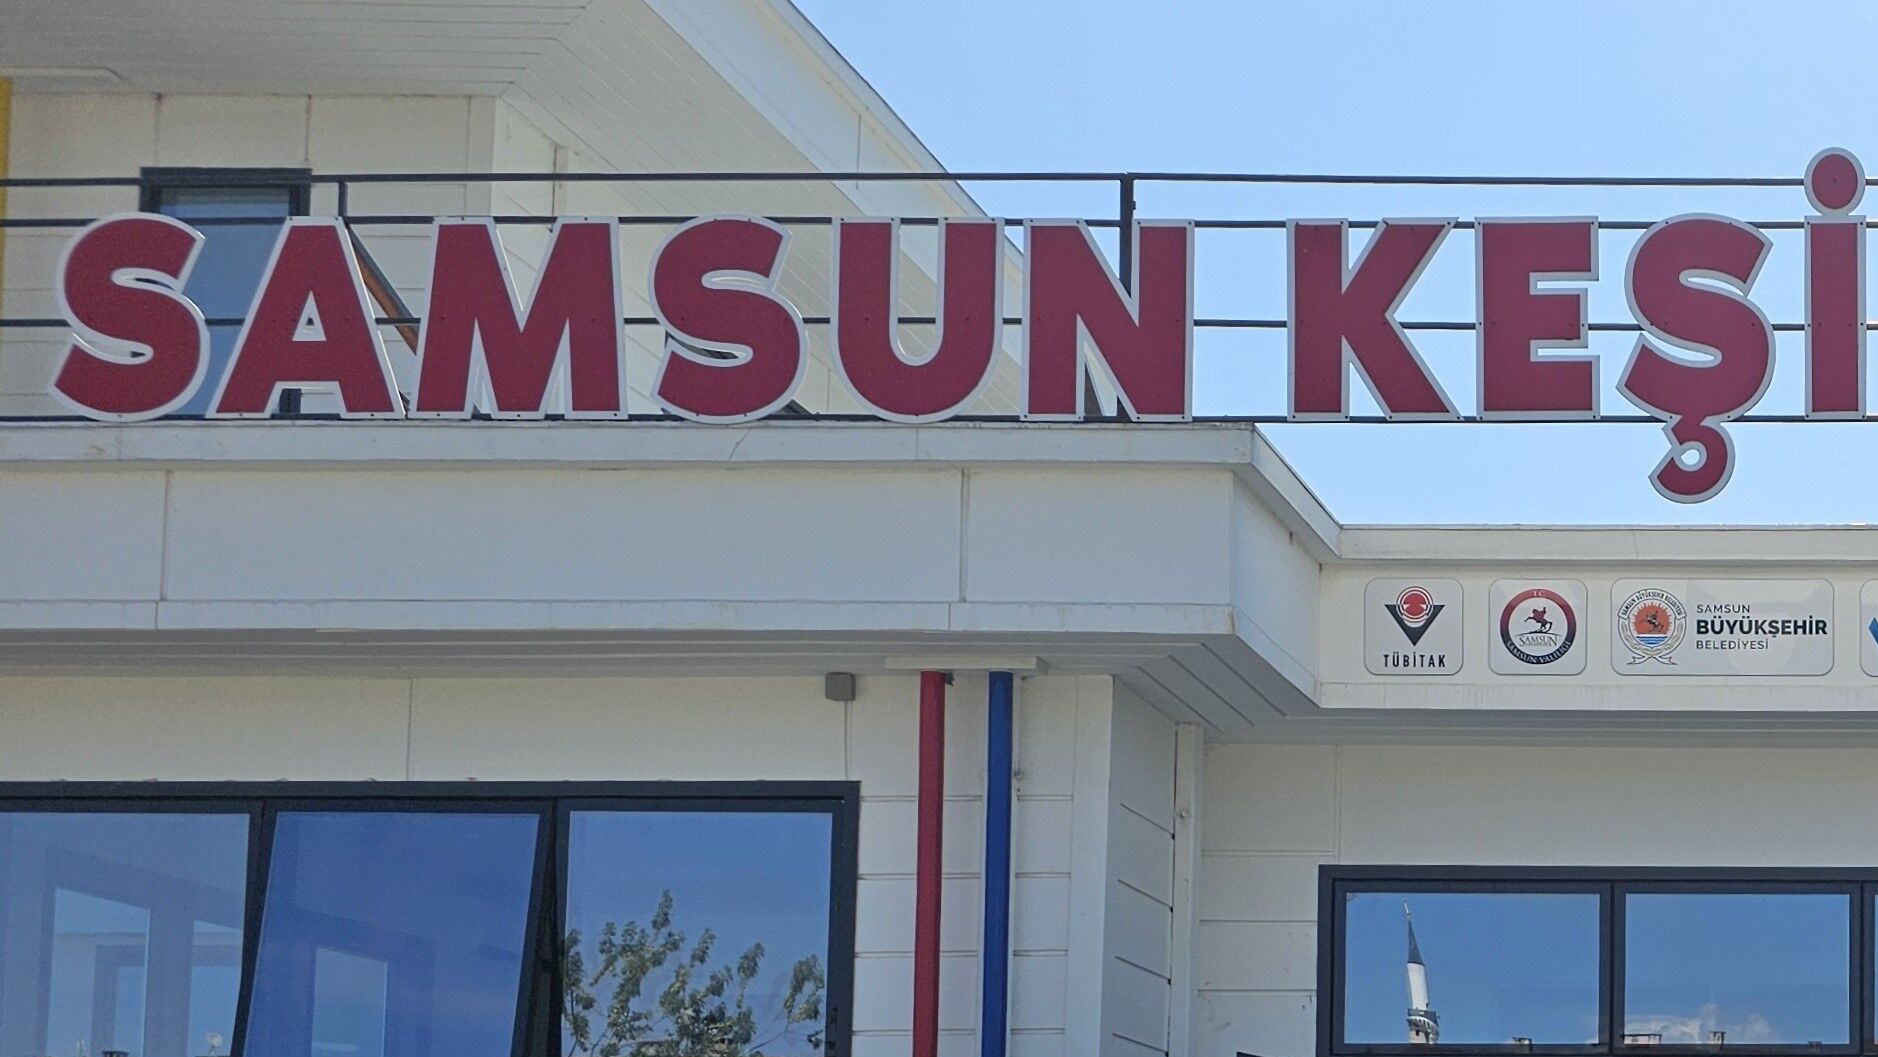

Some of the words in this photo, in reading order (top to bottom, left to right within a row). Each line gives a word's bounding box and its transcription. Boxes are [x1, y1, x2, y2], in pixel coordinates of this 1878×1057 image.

[50, 211, 1194, 425] SAMSUN
[1696, 604, 1750, 613] SAMSUN
[1696, 616, 1828, 638] BÜYÜKŞEHİR
[1696, 639, 1769, 650] BELEDİYESİ
[1383, 651, 1446, 668] TÜBİTAK
